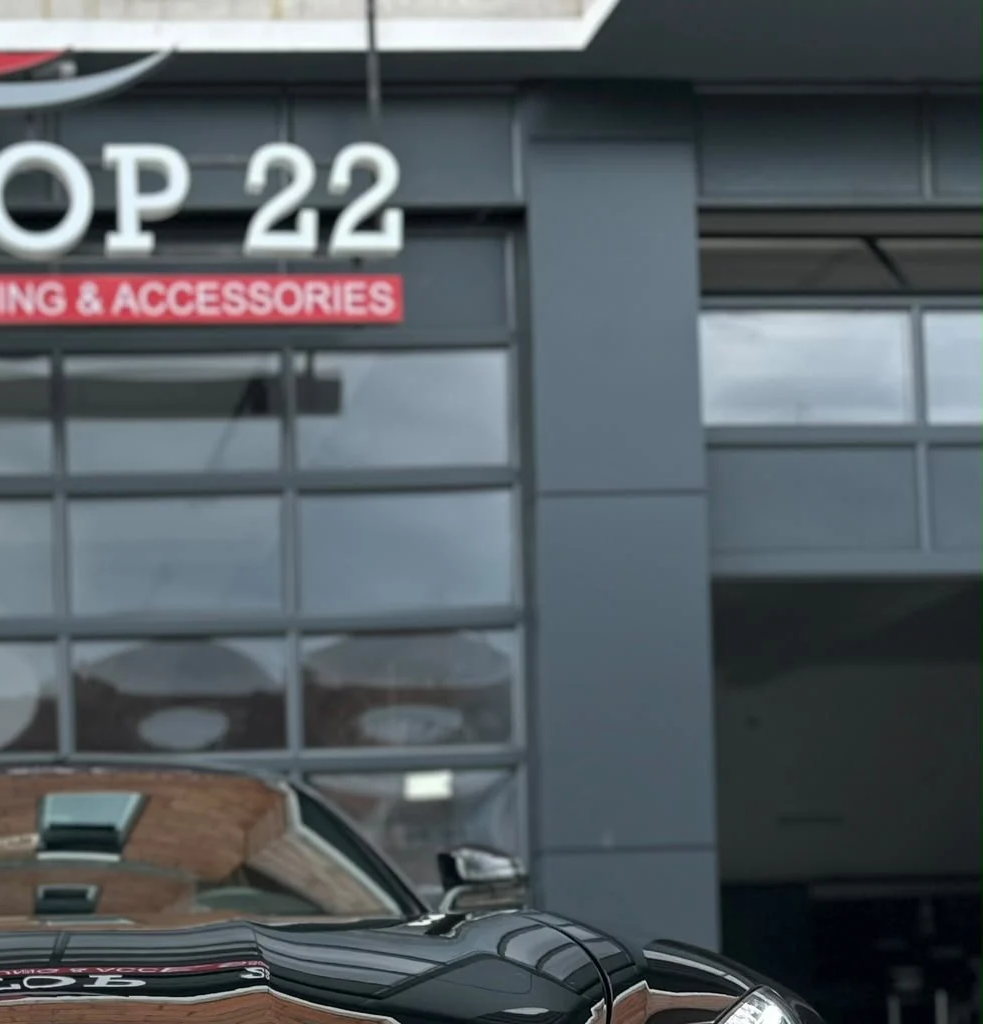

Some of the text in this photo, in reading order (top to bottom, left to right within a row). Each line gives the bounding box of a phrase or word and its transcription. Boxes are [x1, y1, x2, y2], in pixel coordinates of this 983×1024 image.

[242, 141, 405, 257] 22
[75, 280, 103, 317] &
[111, 280, 395, 317] ACCESSORIES
